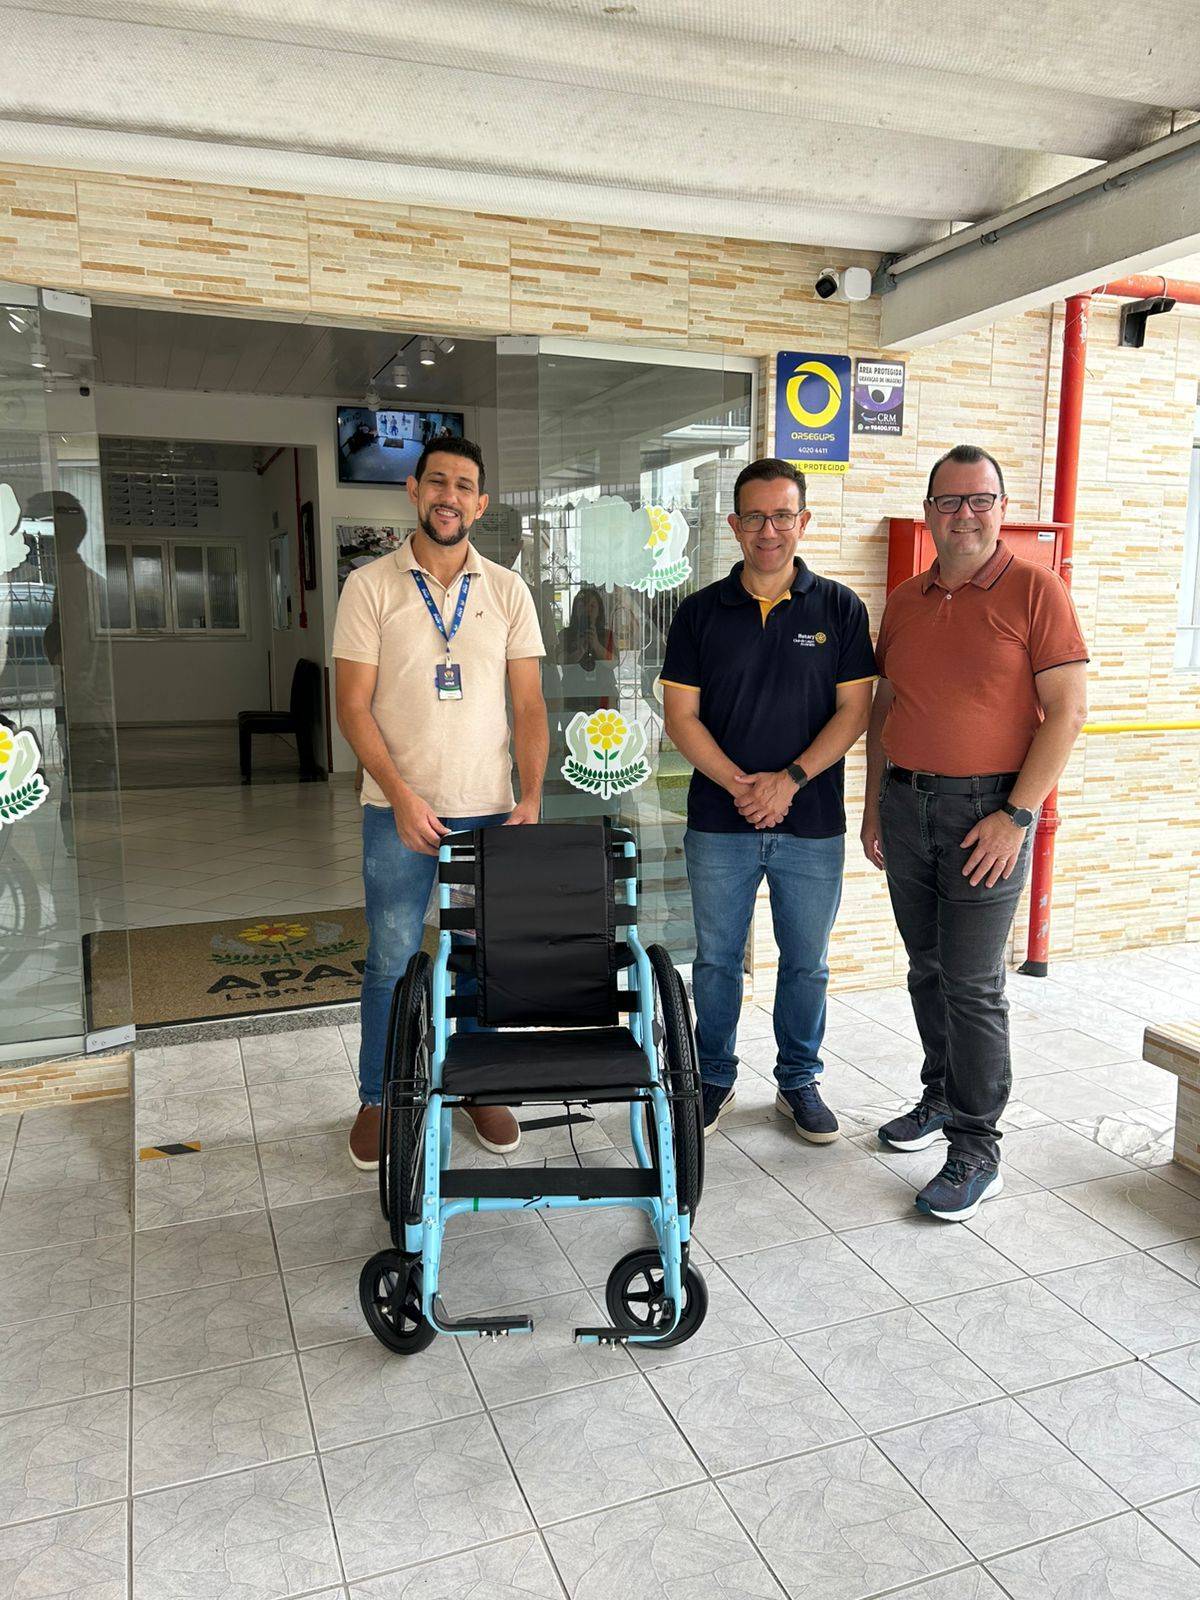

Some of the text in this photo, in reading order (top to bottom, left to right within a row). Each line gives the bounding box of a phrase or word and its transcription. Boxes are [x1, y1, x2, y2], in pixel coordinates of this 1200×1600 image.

[873, 367, 902, 376] PROTEGIDA
[877, 412, 897, 423] CRM
[791, 431, 836, 442] ORSEGUPS
[798, 446, 814, 454] 4020
[803, 463, 846, 471] PROTEGIDO
[206, 959, 369, 994] APA
